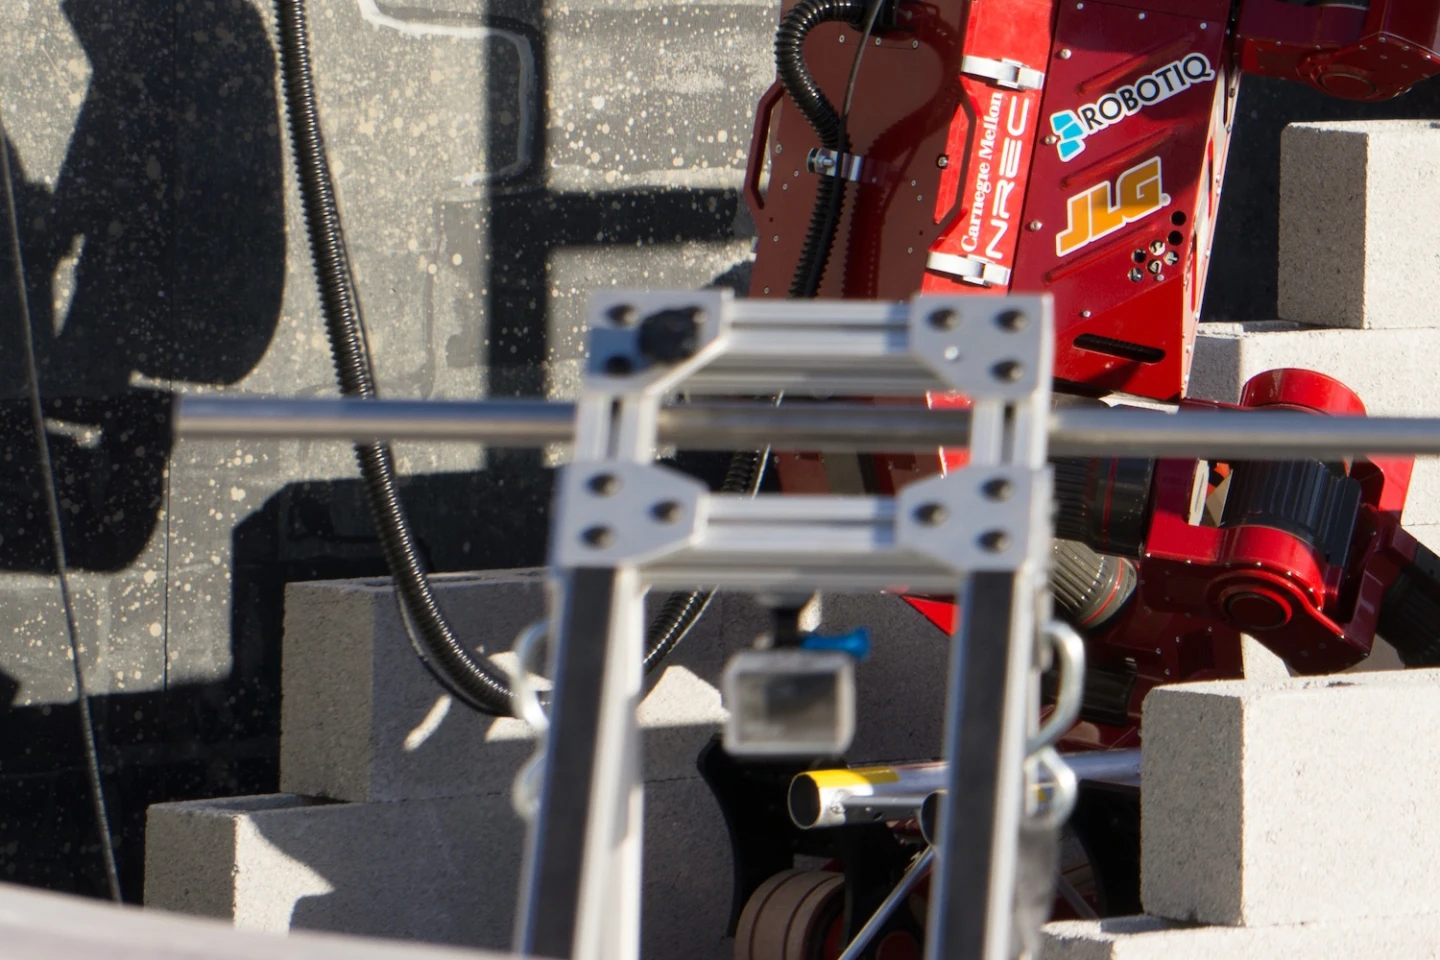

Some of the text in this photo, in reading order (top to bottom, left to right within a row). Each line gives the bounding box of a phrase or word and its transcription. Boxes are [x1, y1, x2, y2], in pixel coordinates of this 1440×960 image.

[1080, 54, 1214, 128] ROBOTIQ
[961, 92, 1004, 252] Carnegie Mellon
[985, 97, 1030, 260] NREC
[1057, 156, 1163, 257] JLG
